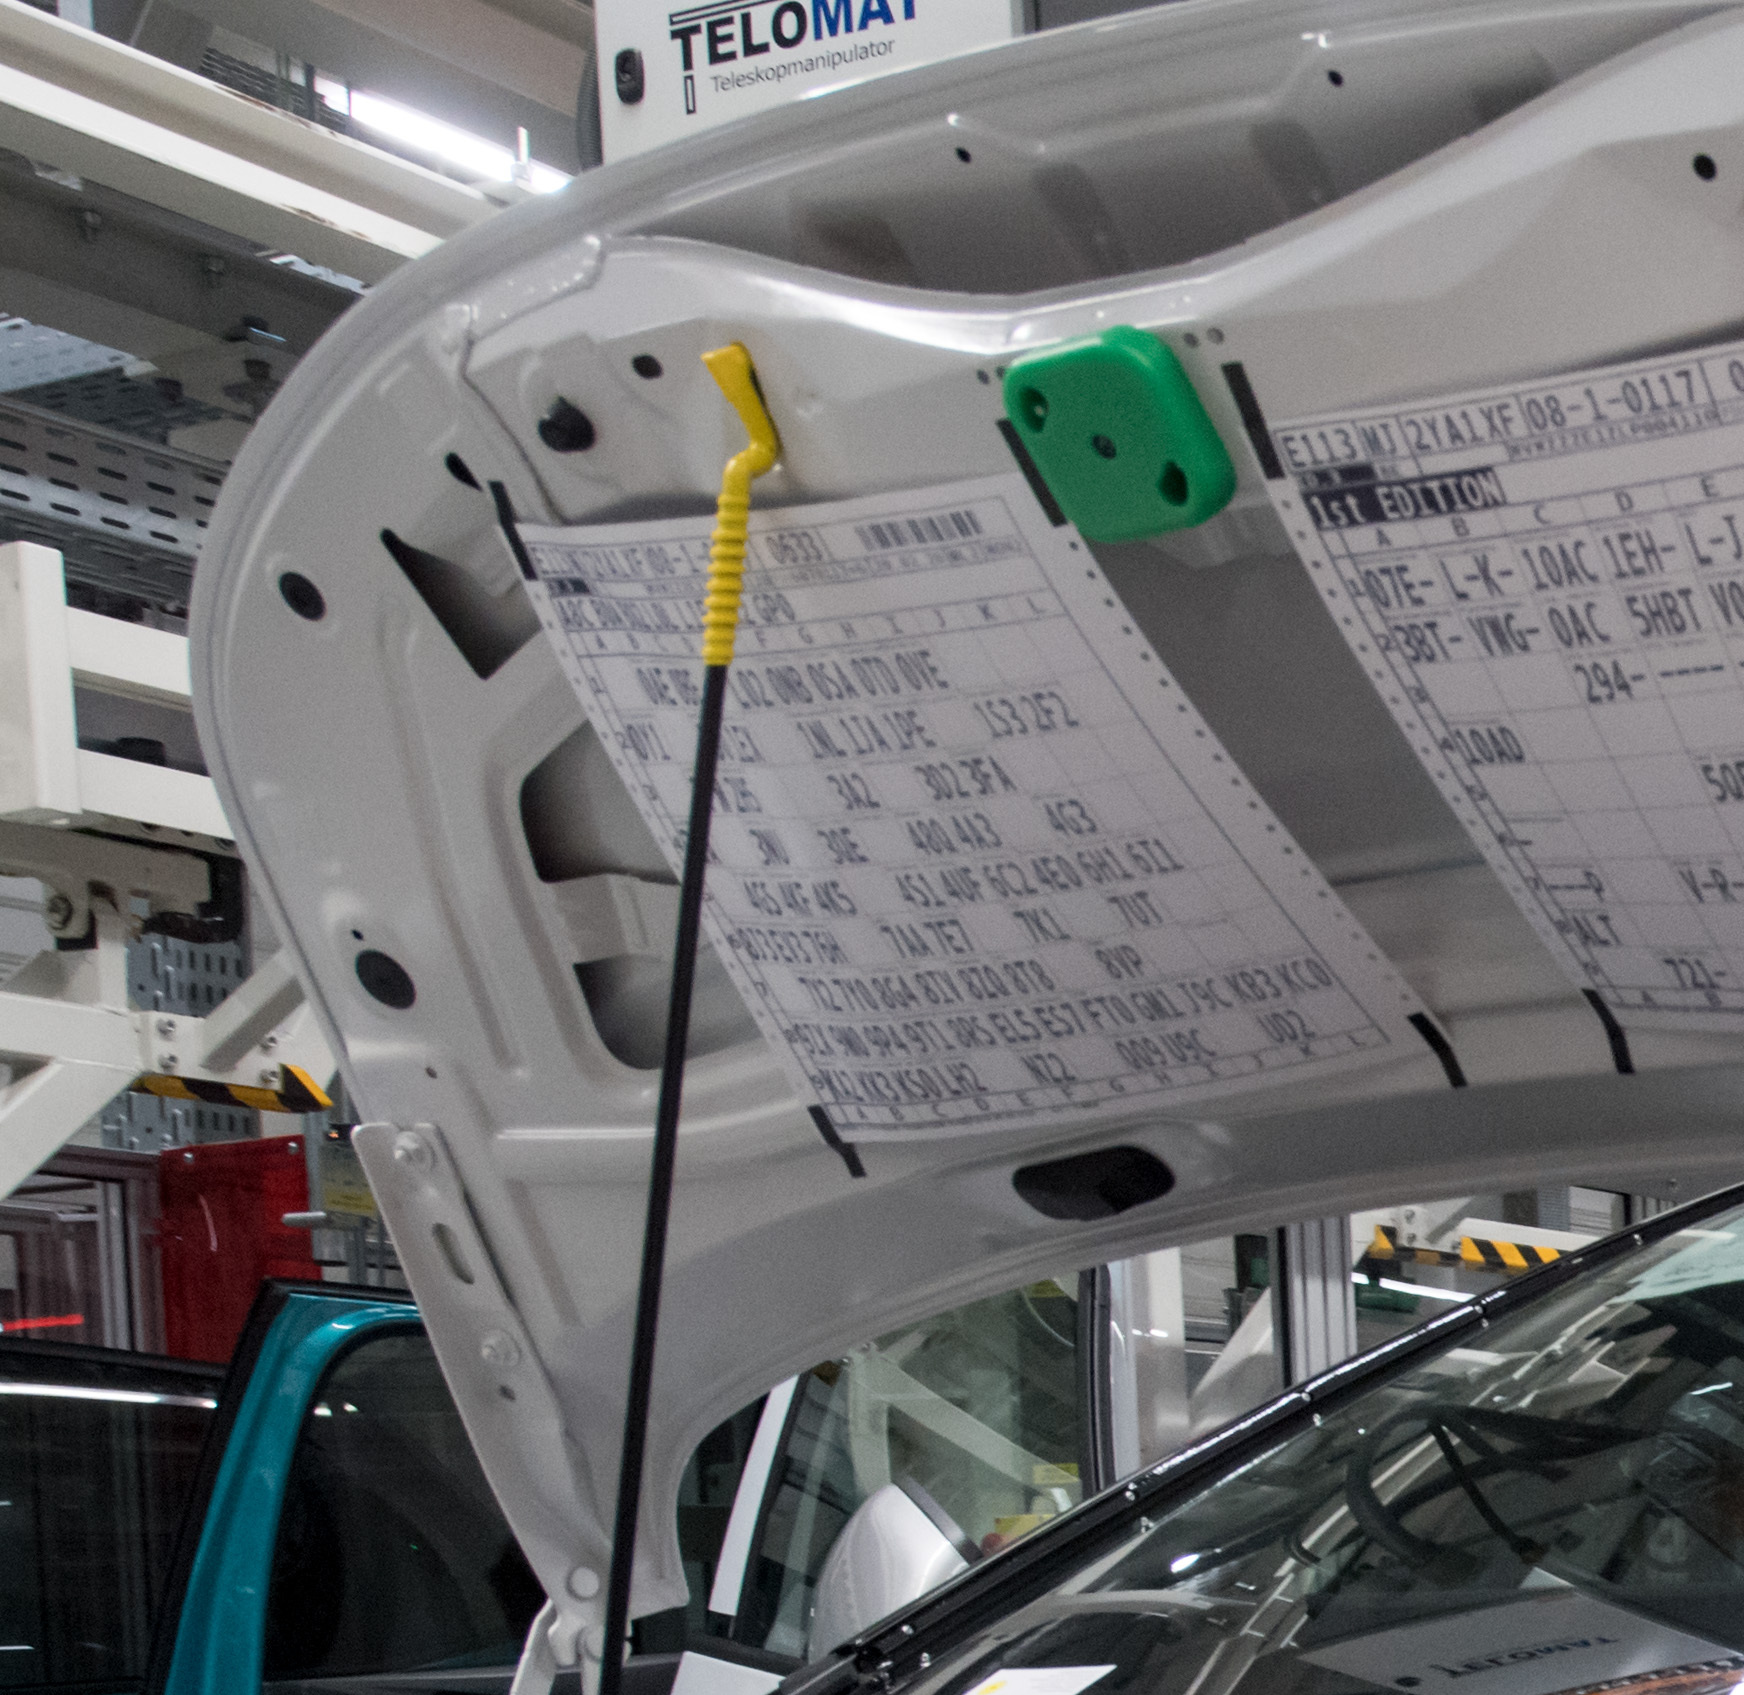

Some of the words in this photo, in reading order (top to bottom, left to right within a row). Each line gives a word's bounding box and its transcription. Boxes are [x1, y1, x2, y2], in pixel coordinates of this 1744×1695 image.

[709, 38, 896, 93] Teleskopmanipulator
[1282, 426, 1358, 468] E113
[1406, 402, 1514, 451] 2YA1XF
[1525, 368, 1697, 432] 08-1-0117
[1310, 494, 1368, 528] 1st
[1375, 467, 1507, 520] EDITION
[1614, 488, 1634, 512] D
[1700, 475, 1719, 498] E
[1438, 553, 1514, 600] L-K-
[1522, 539, 1600, 591] 10AC
[1602, 528, 1676, 580] 1EH-
[1626, 586, 1702, 638] 5HBT
[1573, 659, 1646, 704] 294-
[973, 699, 1030, 739] 1S3
[1020, 690, 1080, 733] 2F2
[1222, 967, 1283, 1004] KB3
